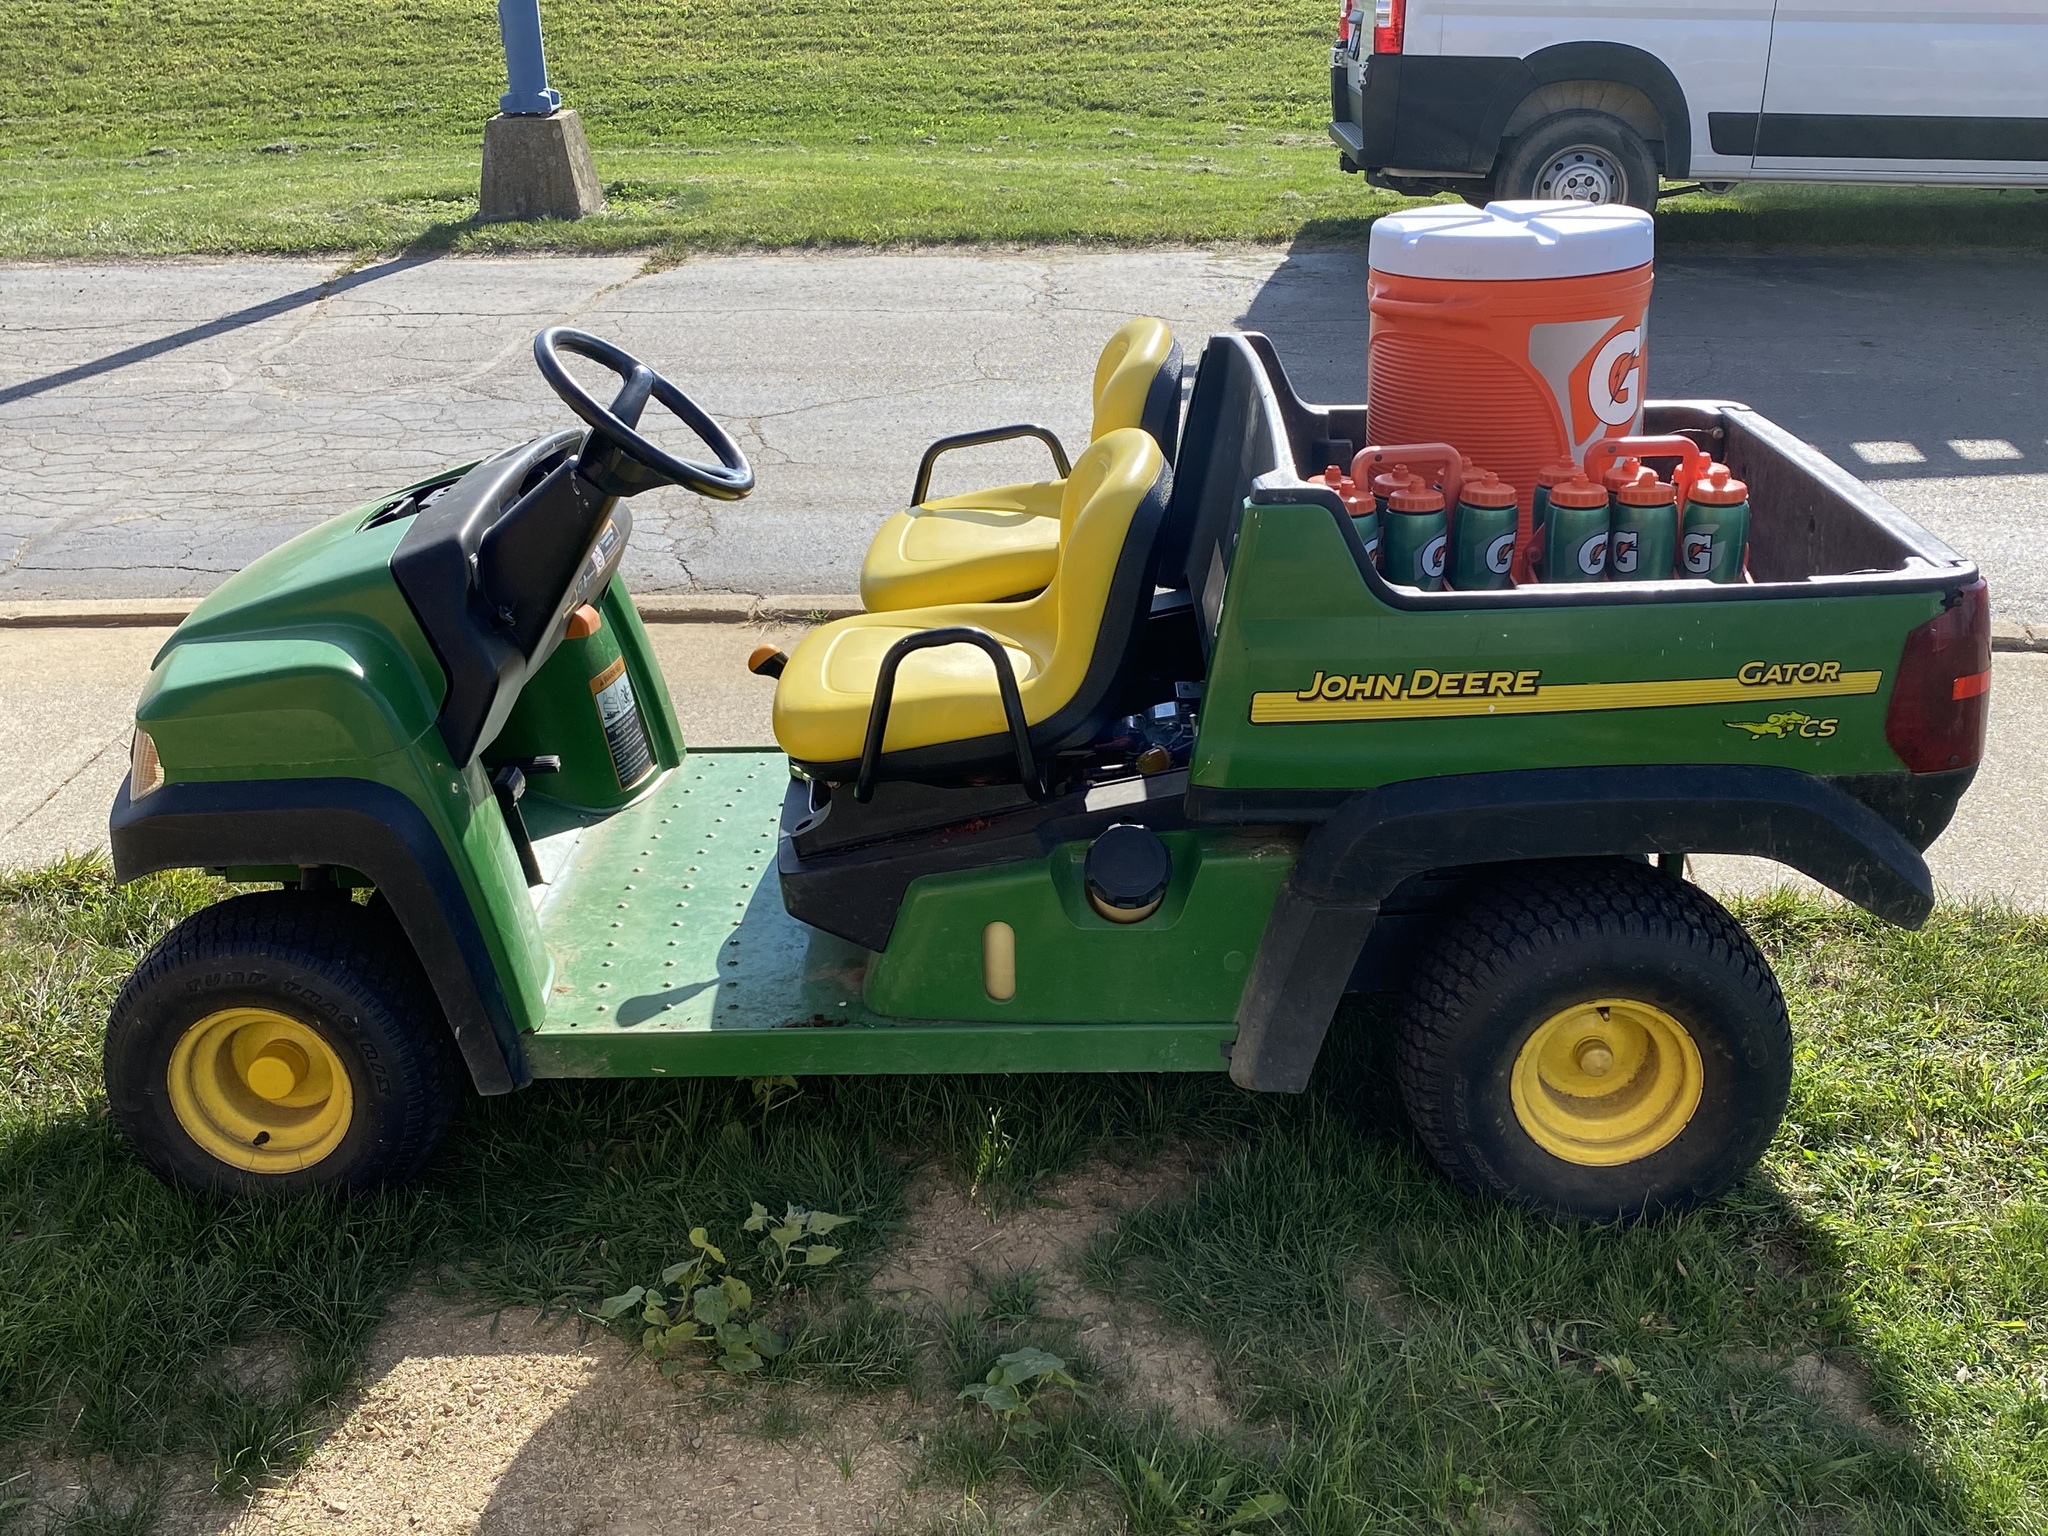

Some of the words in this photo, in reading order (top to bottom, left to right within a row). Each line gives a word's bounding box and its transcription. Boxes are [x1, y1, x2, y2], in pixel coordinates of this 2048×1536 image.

[1588, 324, 1643, 426] G
[1484, 531, 1517, 575] G
[1613, 531, 1639, 573] G
[1682, 533, 1713, 574] G
[1297, 670, 1403, 701] JOHN
[1408, 669, 1542, 698] DEERE
[1738, 661, 1841, 686] GATOR
[1799, 717, 1840, 738] CS
